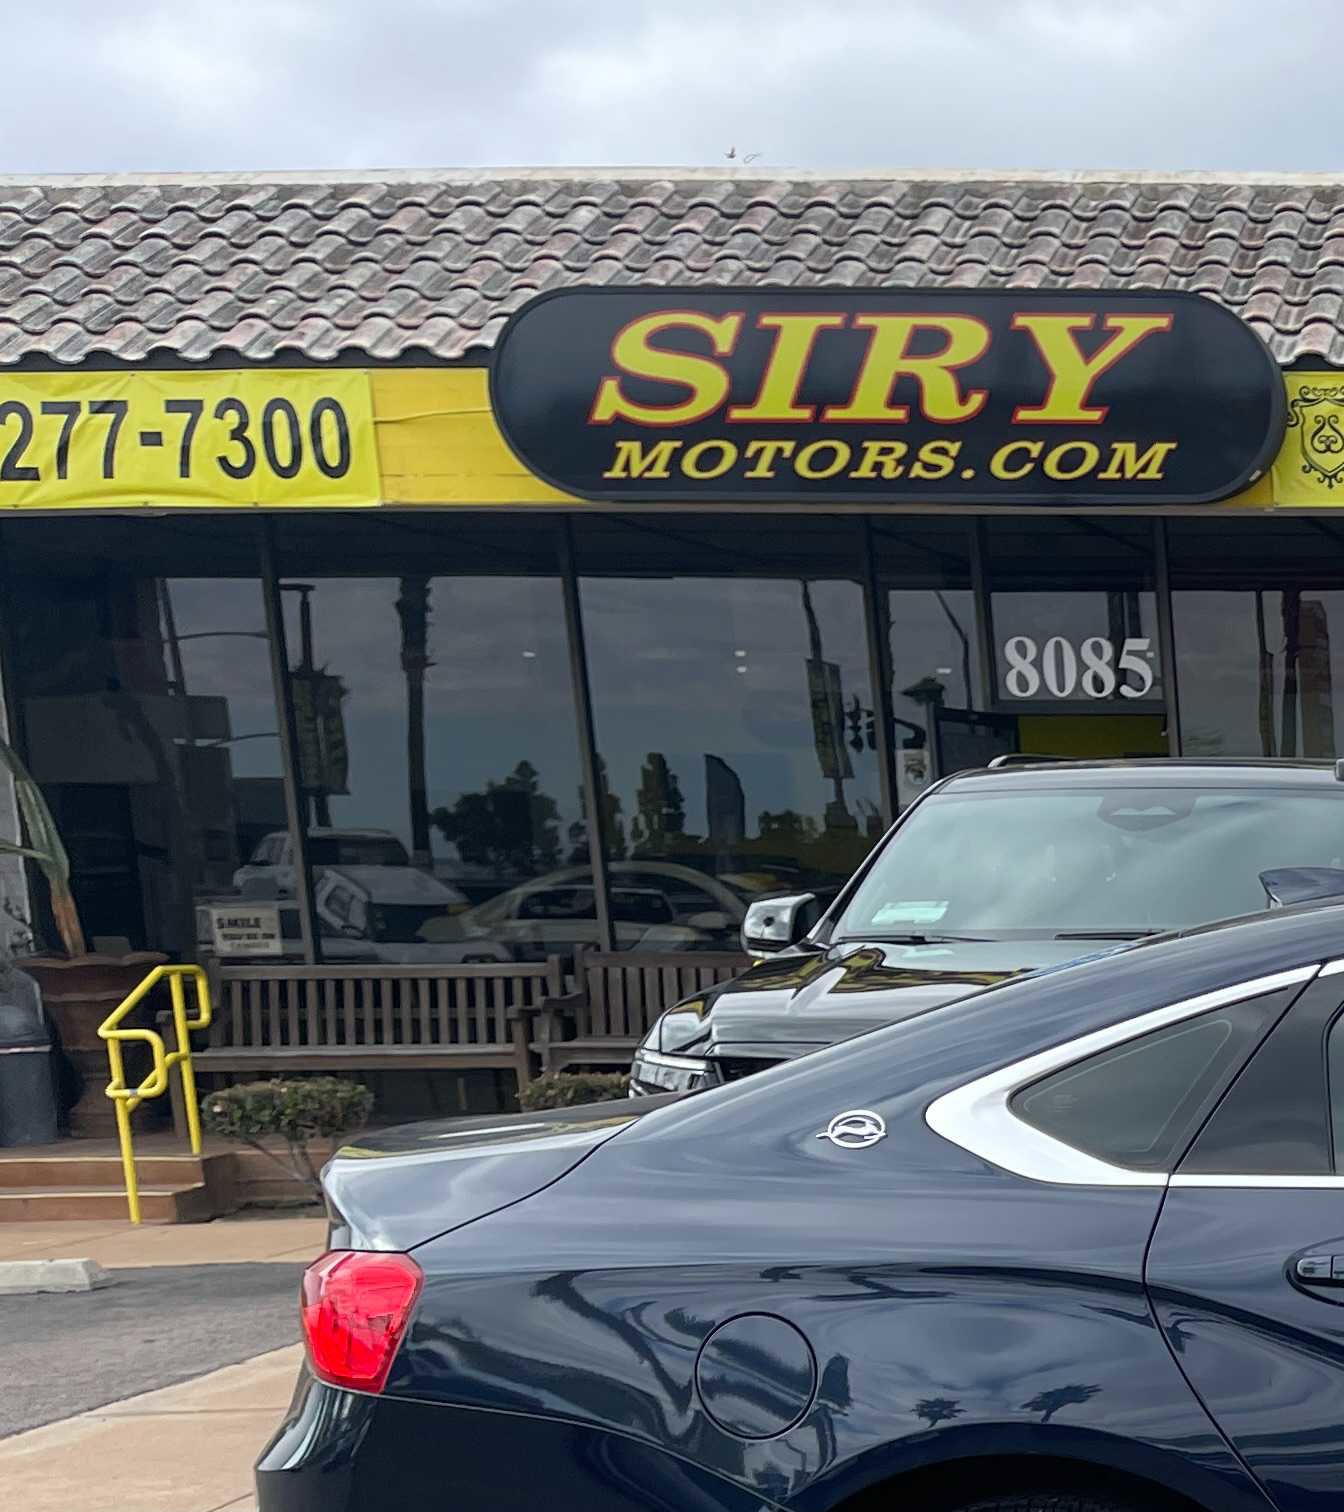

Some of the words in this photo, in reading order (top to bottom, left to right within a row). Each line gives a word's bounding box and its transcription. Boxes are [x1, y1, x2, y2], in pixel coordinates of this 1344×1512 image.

[588, 308, 1175, 425] SIRY
[0, 397, 351, 481] 277-7300
[602, 439, 1178, 481] MOTORS.COM
[1004, 636, 1154, 698] 8085
